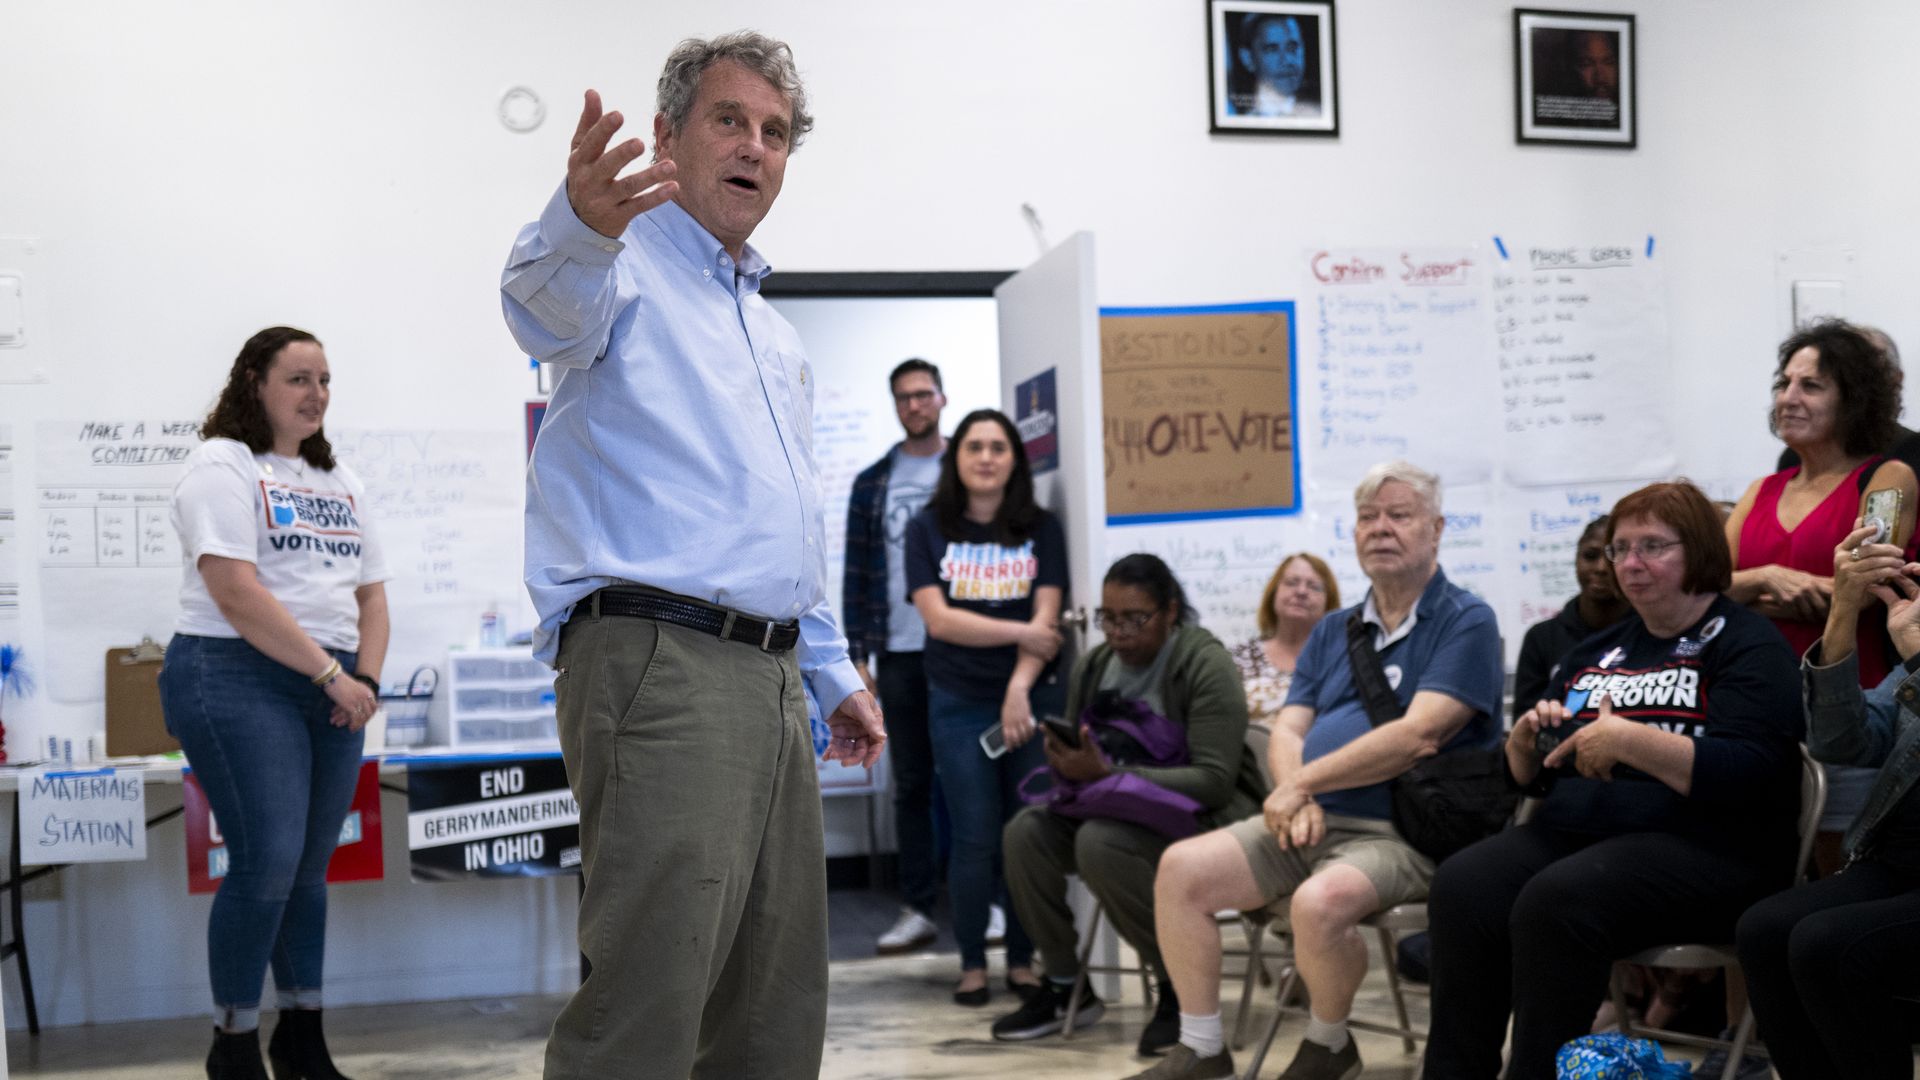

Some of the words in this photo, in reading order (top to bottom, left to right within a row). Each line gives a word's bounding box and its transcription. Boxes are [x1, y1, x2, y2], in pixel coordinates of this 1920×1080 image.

[1400, 252, 1474, 282] Support
[78, 422, 126, 442] MAKE
[132, 422, 145, 440] A
[161, 423, 200, 436] WEEK
[269, 533, 324, 553] VOTE
[941, 557, 1039, 581] SHERROD
[1572, 666, 1699, 691] SHERROD
[1586, 686, 1698, 709] BROWN
[31, 776, 140, 802] MATERIALS
[479, 766, 525, 799] END
[423, 796, 580, 840] GERRYMANDERING
[38, 814, 135, 849] STATION
[464, 842, 488, 871] IN
[492, 832, 545, 866] OHIO
